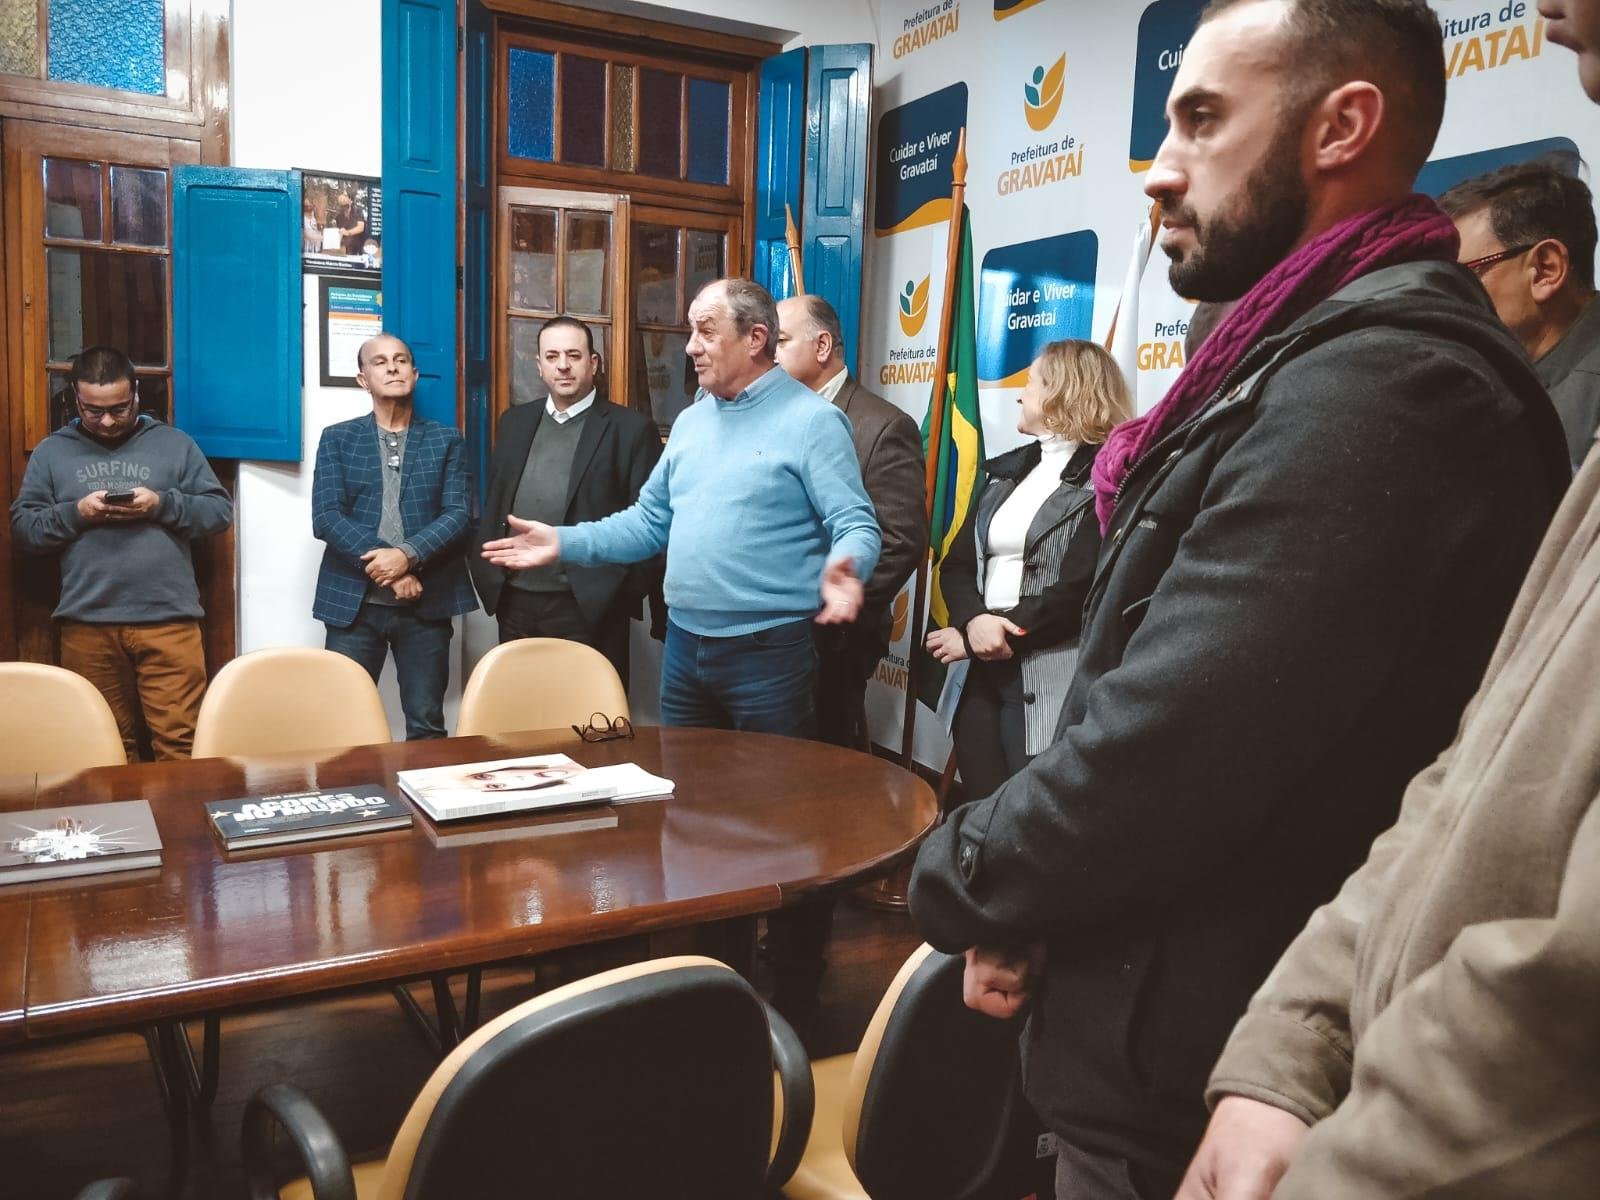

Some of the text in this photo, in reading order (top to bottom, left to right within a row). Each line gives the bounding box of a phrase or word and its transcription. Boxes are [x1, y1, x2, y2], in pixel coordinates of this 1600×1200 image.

[904, 0, 953, 31] Prefeitura de
[1443, 0, 1526, 39] itura de
[893, 2, 960, 60] GRAVATAÍ
[1158, 44, 1183, 71] Cui
[890, 131, 952, 163] Cuidar e Viver
[1010, 135, 1075, 165] Prefeitura de
[900, 153, 938, 180] Gravataí
[997, 144, 1085, 196] GRAVATAÍ
[1033, 289, 1041, 303] e
[1043, 283, 1076, 302] Viver
[1007, 307, 1058, 330] Gravataí
[1154, 320, 1188, 337] Prefe
[889, 345, 936, 361] Prefeitura de
[880, 361, 937, 385] GRAVATA
[76, 460, 151, 483] SURFING
